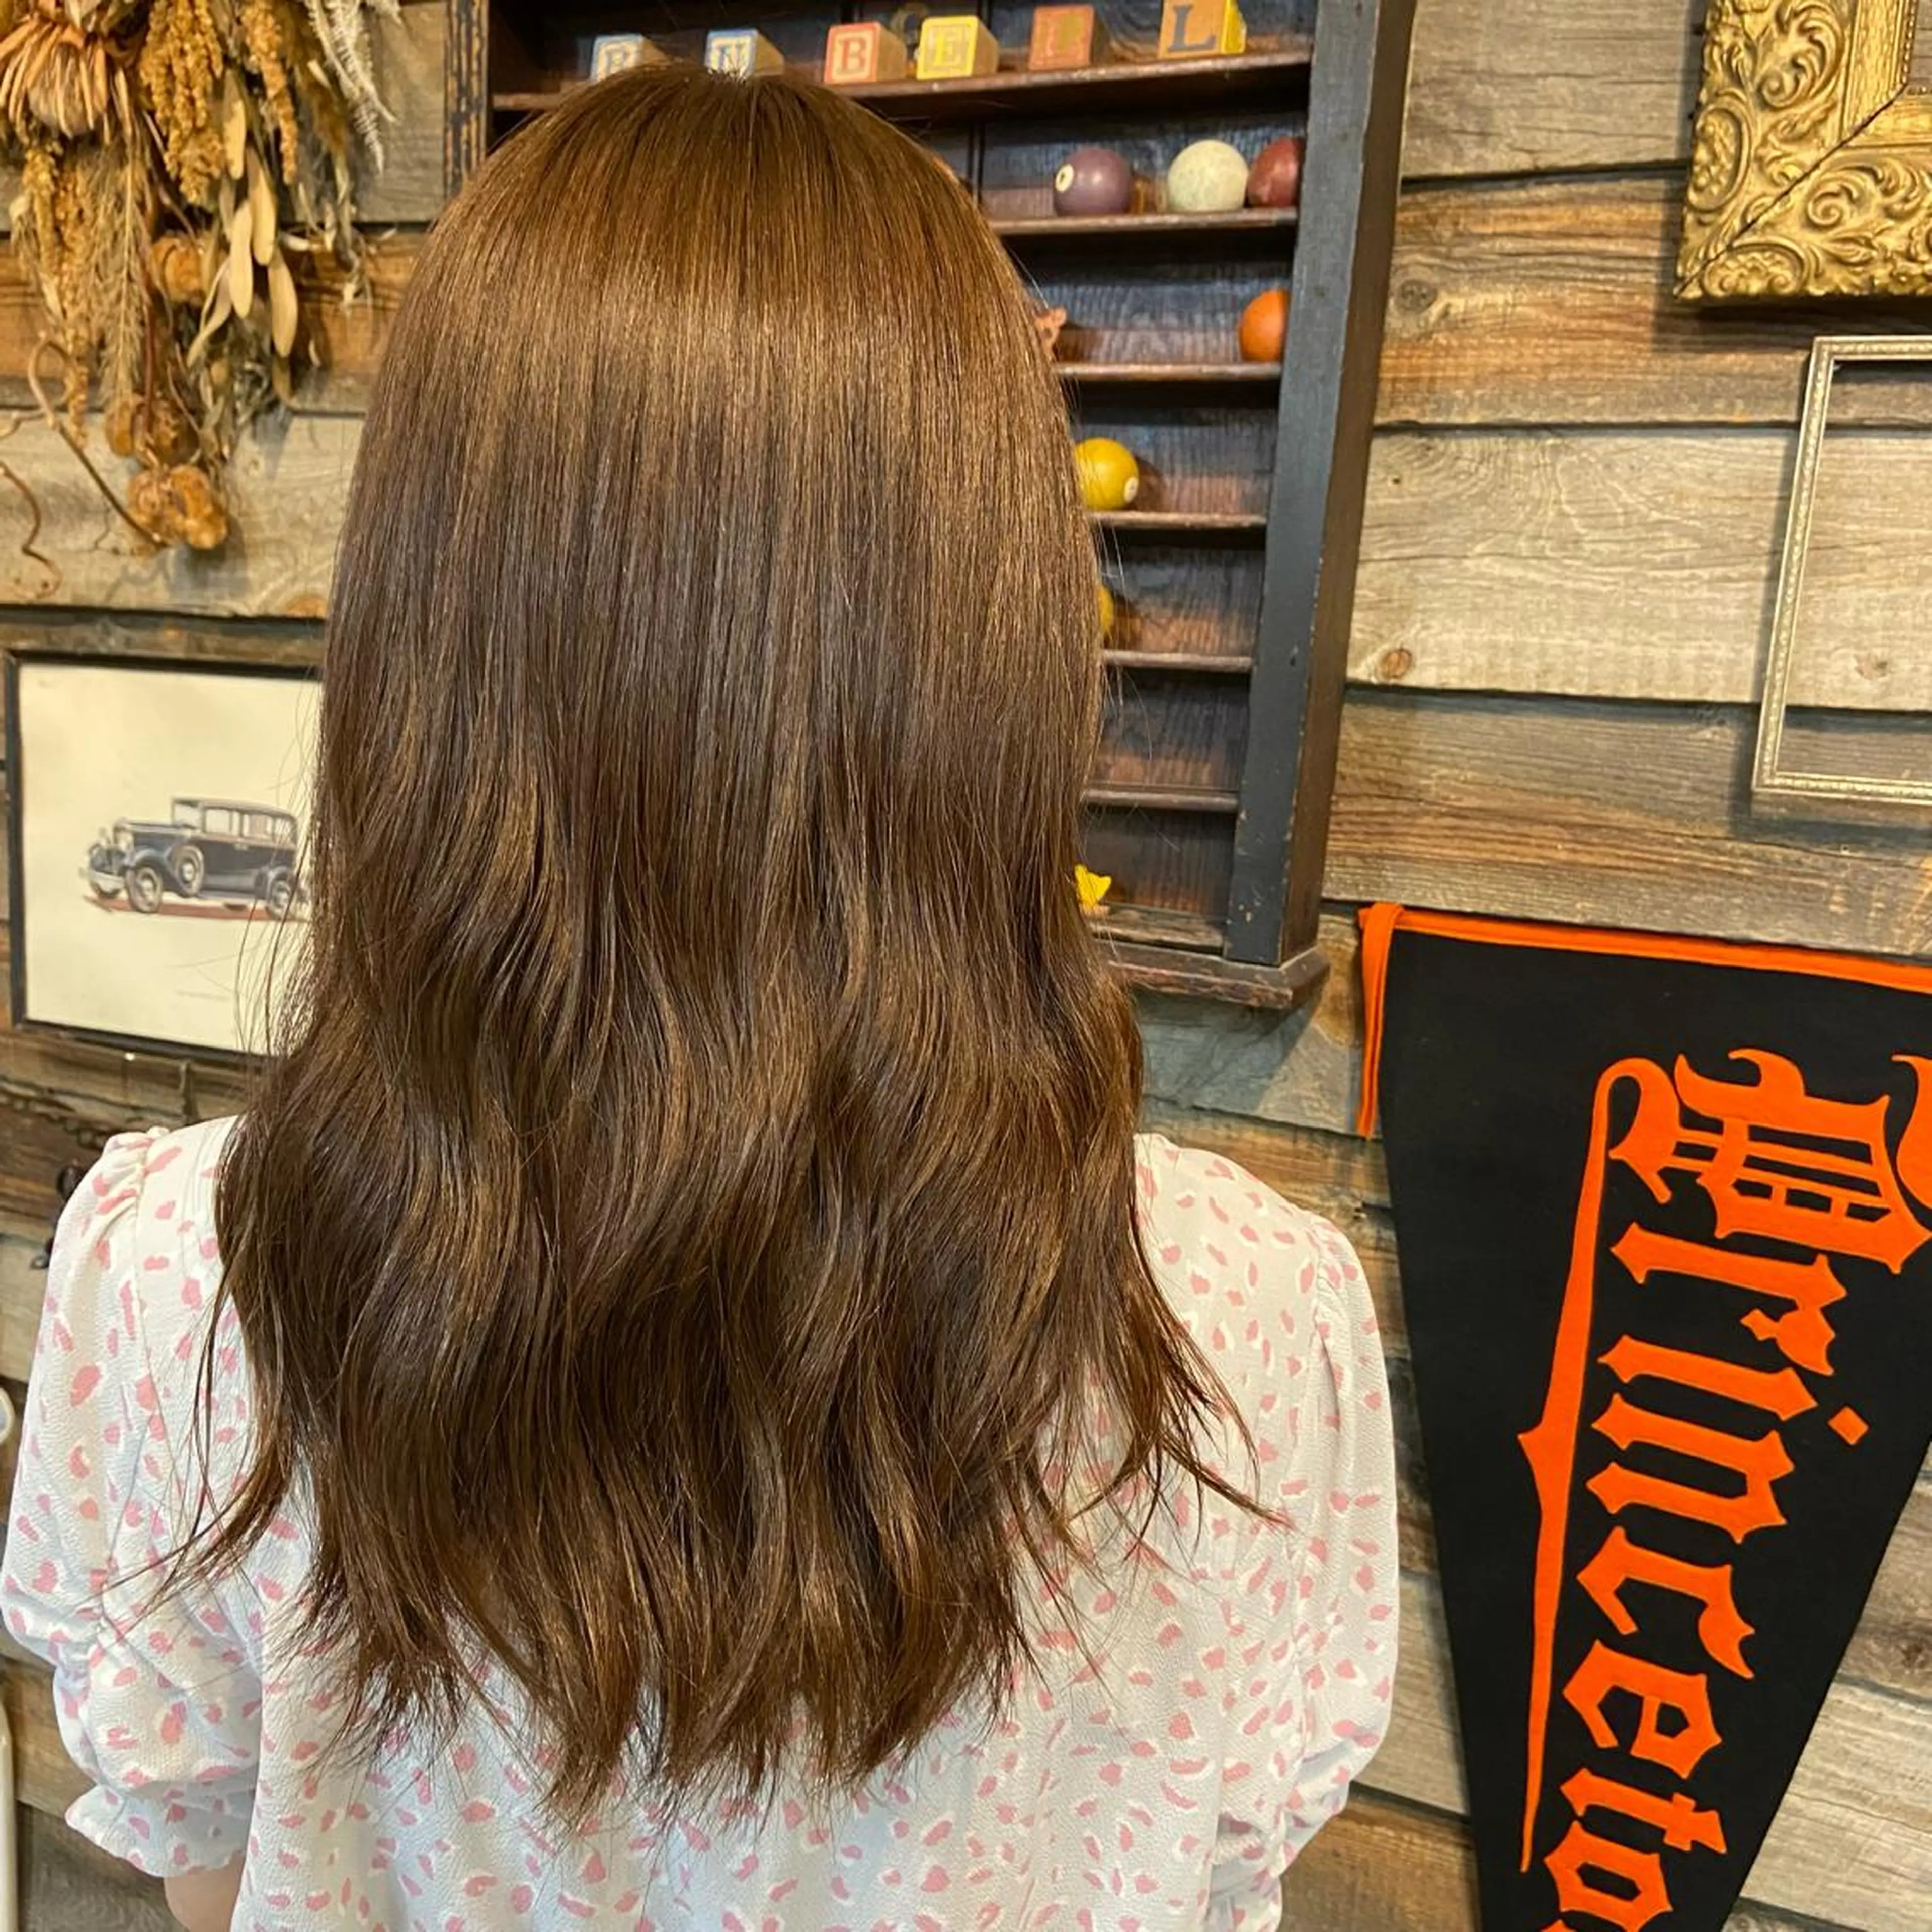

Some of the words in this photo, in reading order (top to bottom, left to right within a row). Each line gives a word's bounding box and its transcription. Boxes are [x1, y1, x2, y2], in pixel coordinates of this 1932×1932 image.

[1168, 5, 1217, 52] L
[837, 37, 867, 75] B
[1518, 1049, 1932, 1932] Princeto
